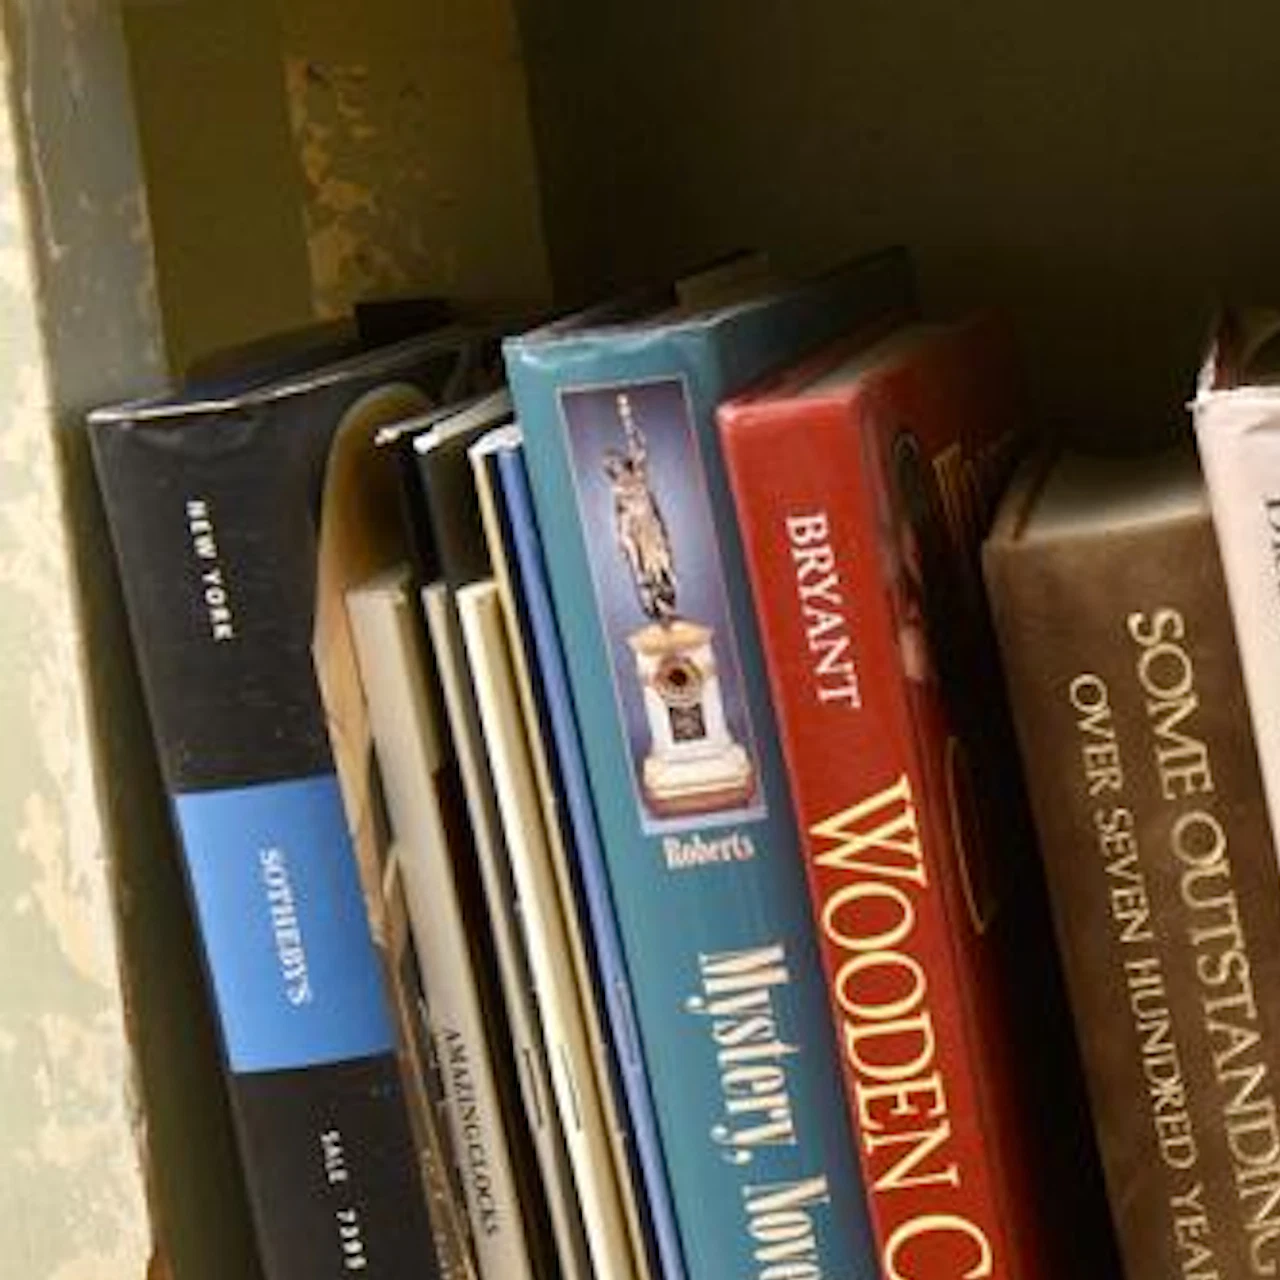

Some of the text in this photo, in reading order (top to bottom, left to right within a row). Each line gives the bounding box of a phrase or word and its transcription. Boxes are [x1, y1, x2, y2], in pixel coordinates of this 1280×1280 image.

[186, 500, 234, 642] NEW YORK
[786, 509, 861, 710] BRYANT
[1068, 672, 1126, 798] OVER
[1128, 607, 1215, 800] SOME
[258, 846, 313, 1008] SOTHEBY'S
[664, 834, 755, 871] Roberts
[1095, 806, 1156, 944] SEVEN
[680, 943, 800, 1164] Mystery,
[809, 774, 960, 1194] WOODEN
[1123, 954, 1198, 1170] HUNDRED
[320, 1129, 348, 1185] SALE
[442, 1025, 481, 1140] AMAZING
[467, 1140, 500, 1238] CLOCKS
